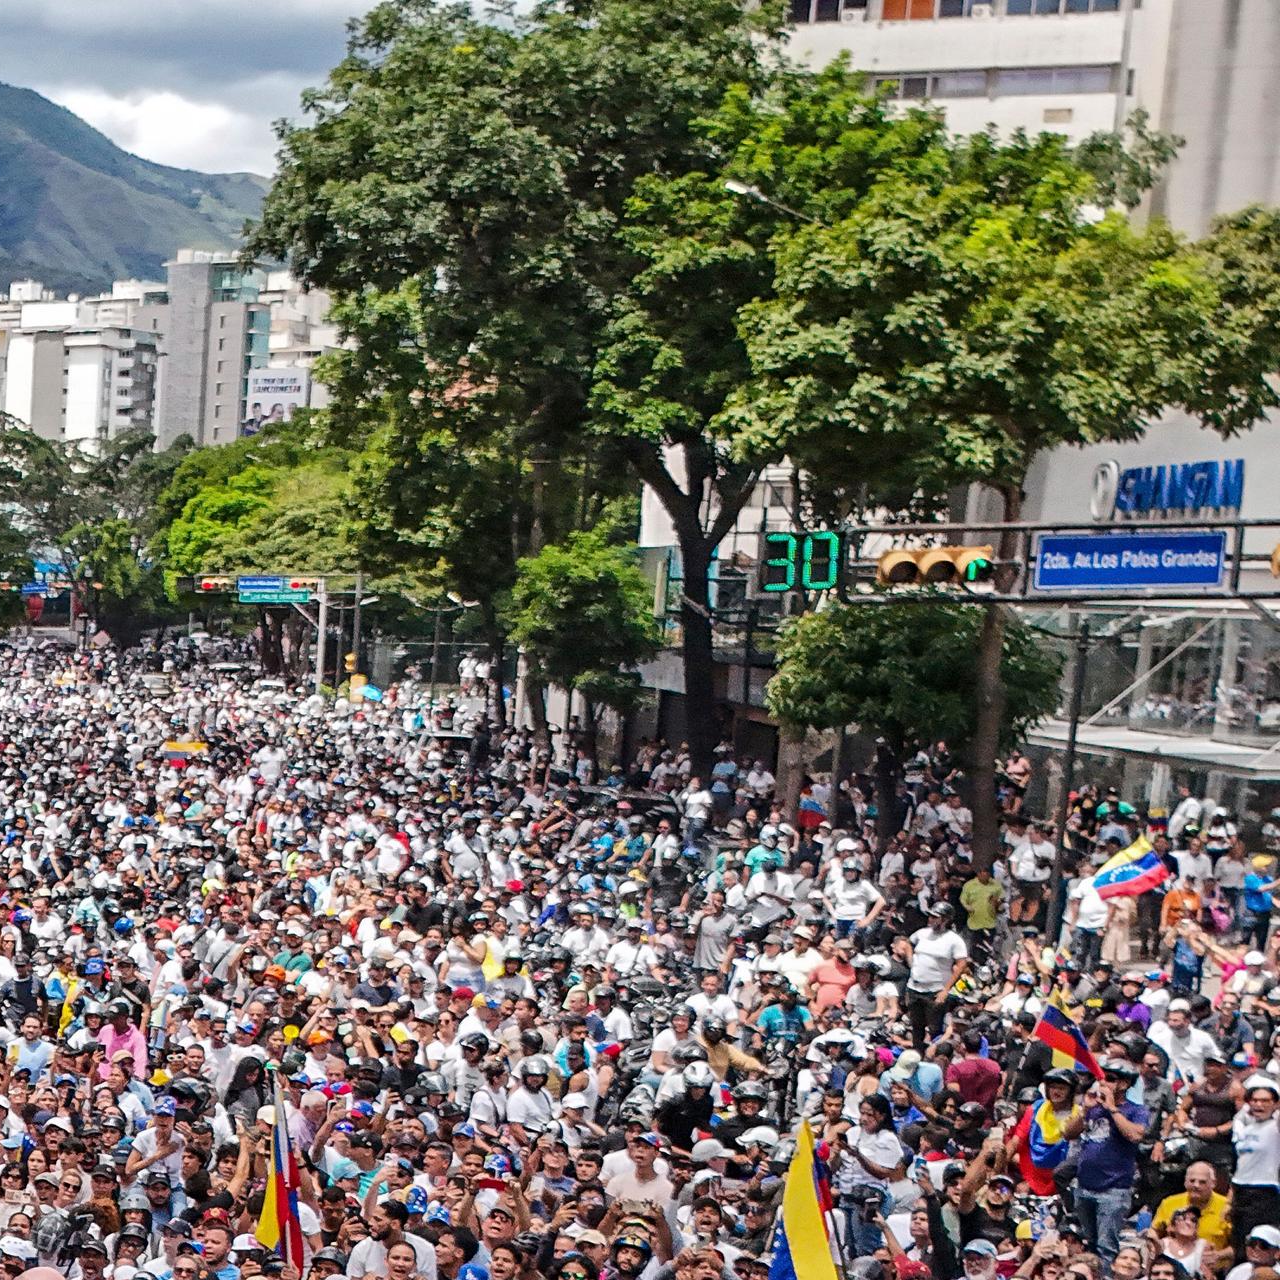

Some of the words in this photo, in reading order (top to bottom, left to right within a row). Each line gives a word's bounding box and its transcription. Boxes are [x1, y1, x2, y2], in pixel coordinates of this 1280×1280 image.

[763, 531, 840, 592] 30
[1092, 550, 1118, 569] Los
[1121, 550, 1158, 568] Palos
[1162, 549, 1217, 568] Grandes
